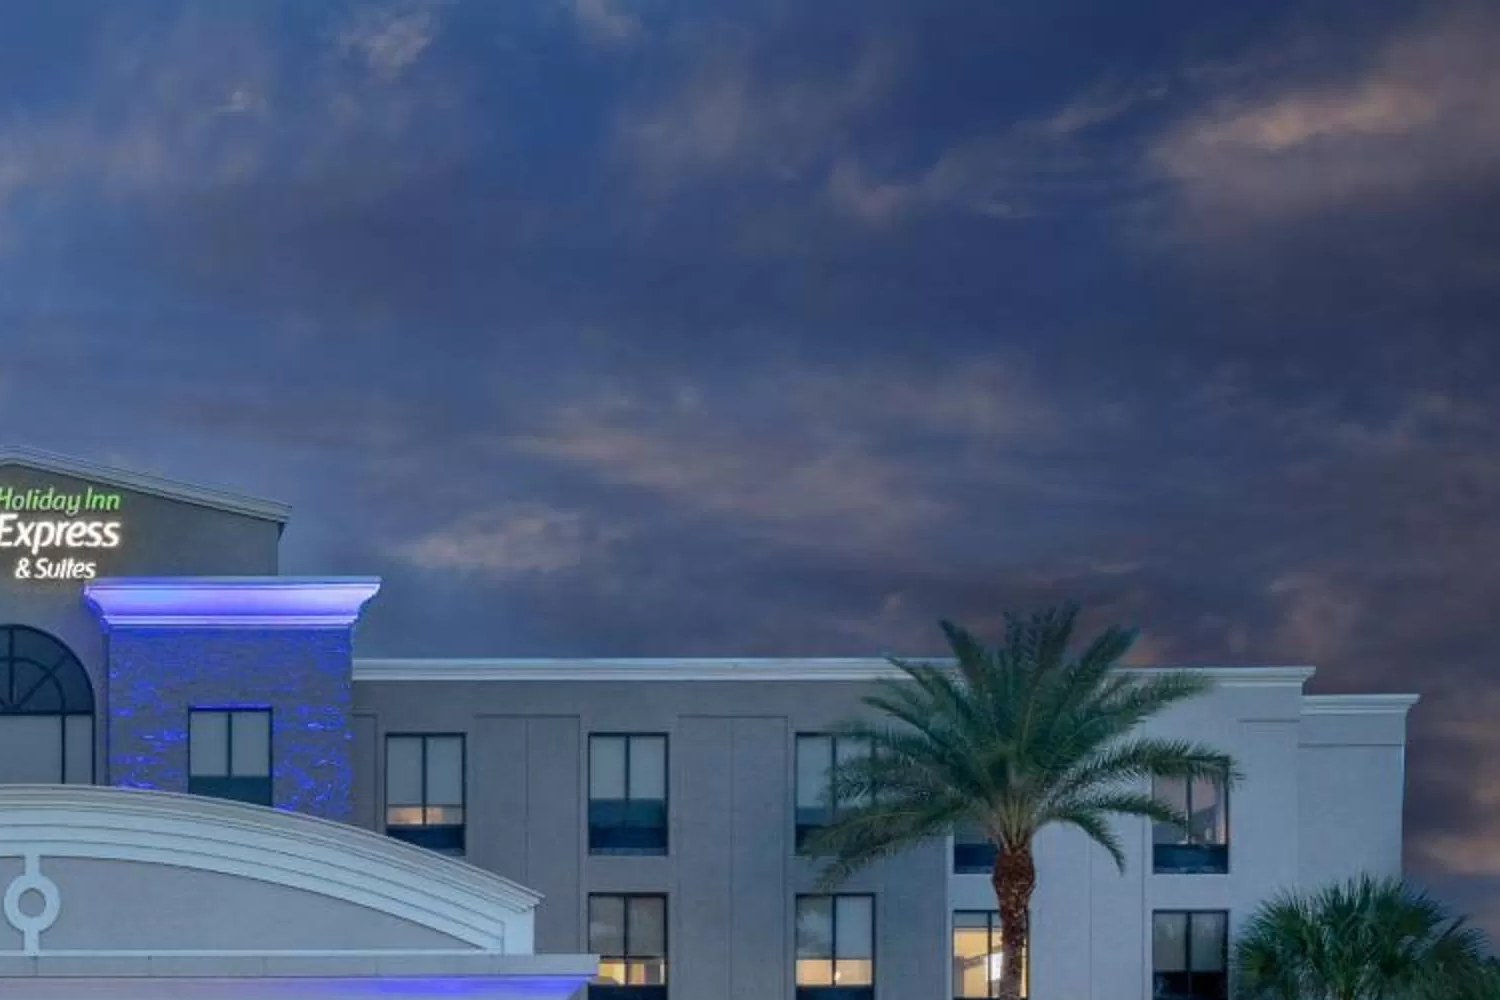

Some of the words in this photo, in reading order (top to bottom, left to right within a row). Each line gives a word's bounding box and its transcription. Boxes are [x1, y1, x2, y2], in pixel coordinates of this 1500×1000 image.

[85, 486, 120, 510] Inn
[15, 557, 31, 579] &
[34, 557, 98, 579] Suites
